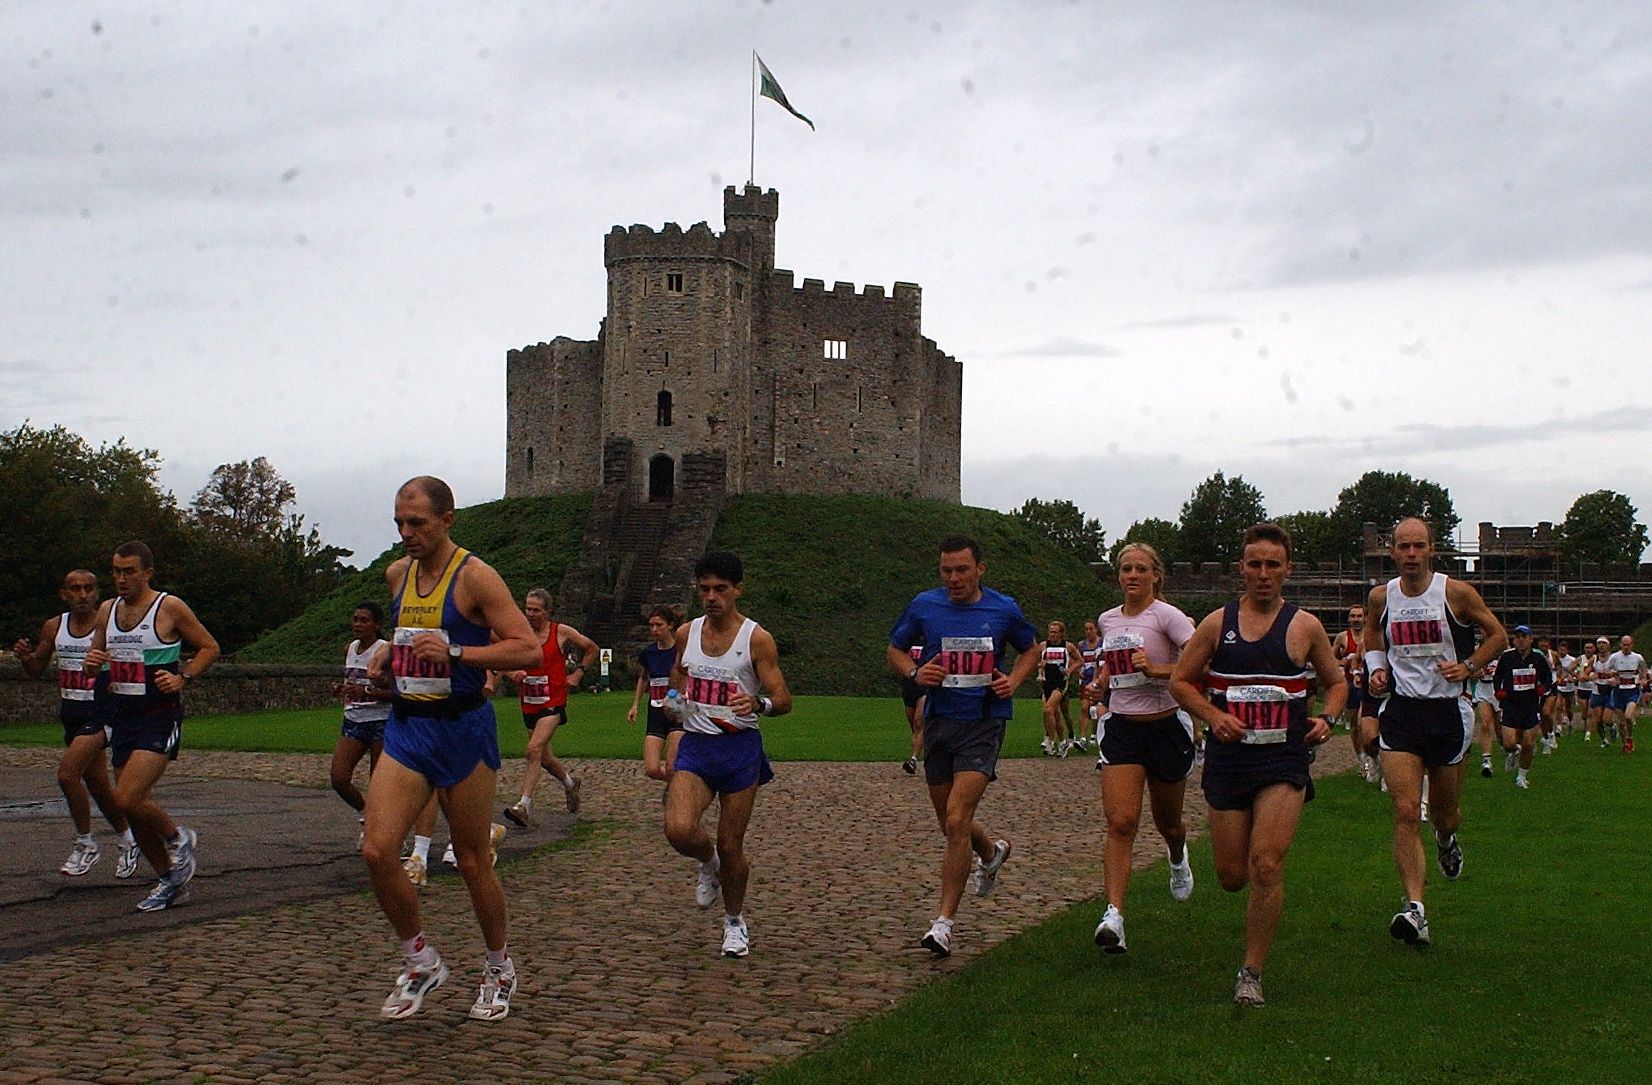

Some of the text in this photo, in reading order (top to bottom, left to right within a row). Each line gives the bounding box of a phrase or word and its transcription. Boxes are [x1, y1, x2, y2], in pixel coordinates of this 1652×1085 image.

[402, 606, 437, 614] BEVERLEY
[1397, 621, 1440, 645] 1168
[949, 651, 986, 674] 807
[693, 678, 728, 705] 818
[1233, 702, 1283, 729] 1097
